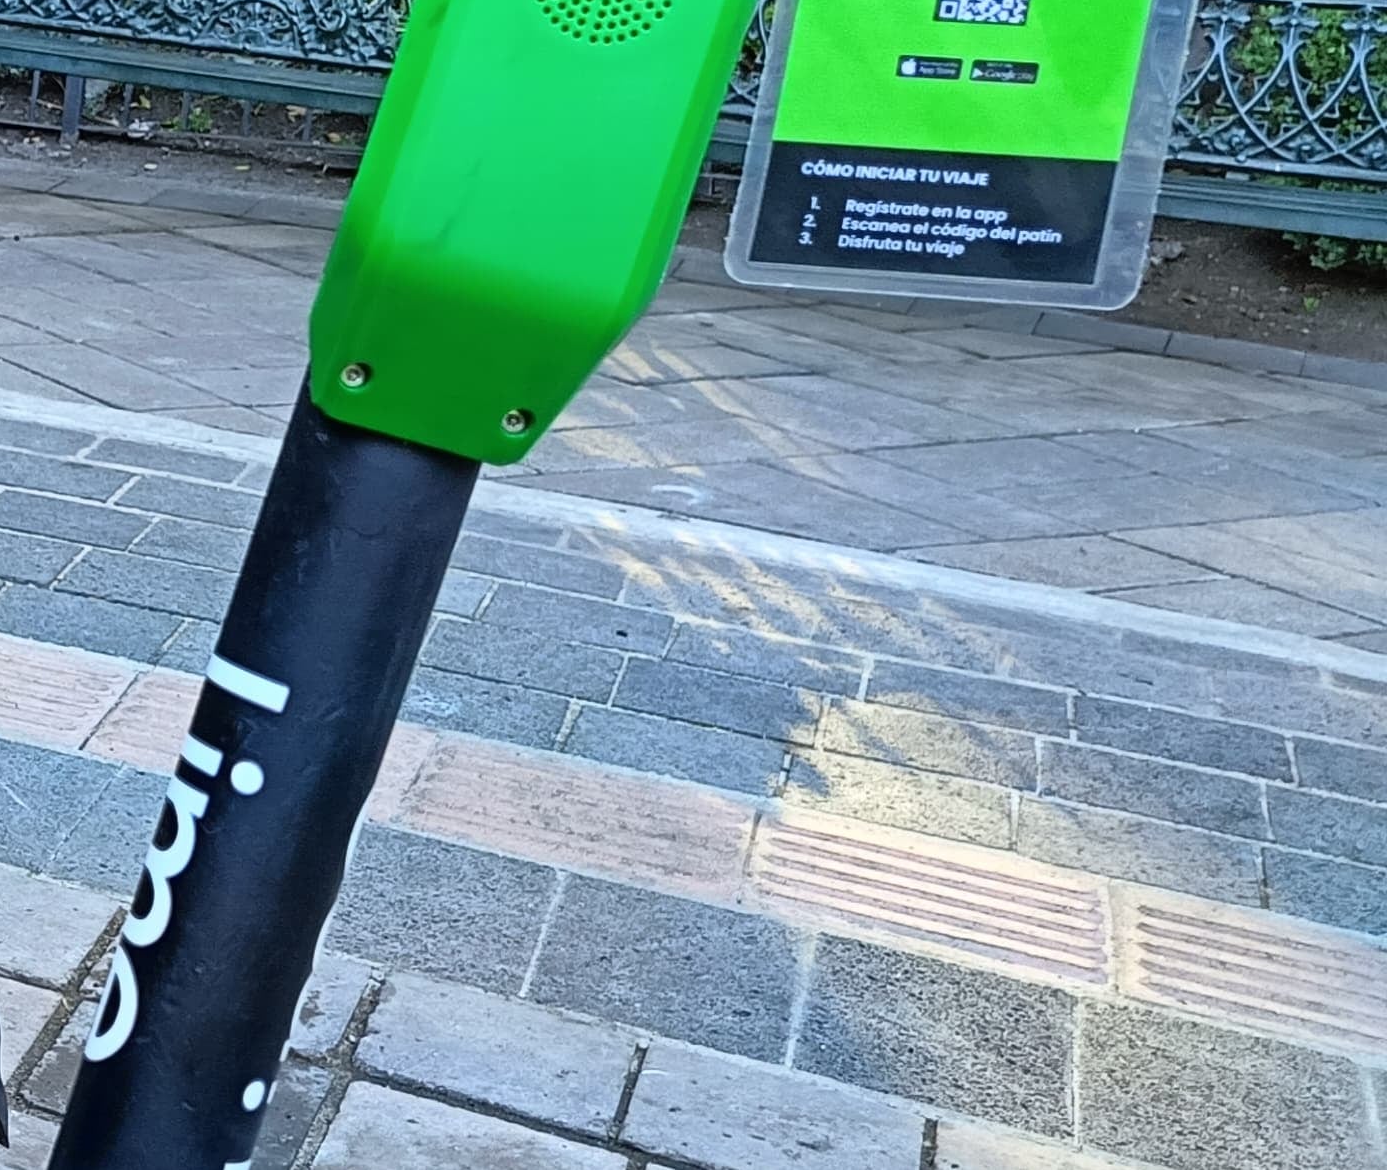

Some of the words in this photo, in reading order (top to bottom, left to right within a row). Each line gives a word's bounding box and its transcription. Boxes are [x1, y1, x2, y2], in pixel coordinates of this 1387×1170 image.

[800, 160, 855, 178] CÓMO
[855, 165, 916, 182] INICIAR
[919, 169, 941, 184] TU
[943, 170, 990, 187] VIAJE
[845, 198, 930, 218] Regístrate
[931, 207, 953, 219] en
[955, 205, 972, 221] la
[974, 208, 1009, 225] app
[841, 216, 912, 235] Escanea
[913, 221, 930, 235] el
[931, 222, 988, 242] código
[989, 226, 1016, 241] del
[837, 234, 903, 251] Disfruta
[904, 238, 924, 253] tu
[925, 240, 966, 259] viaje
